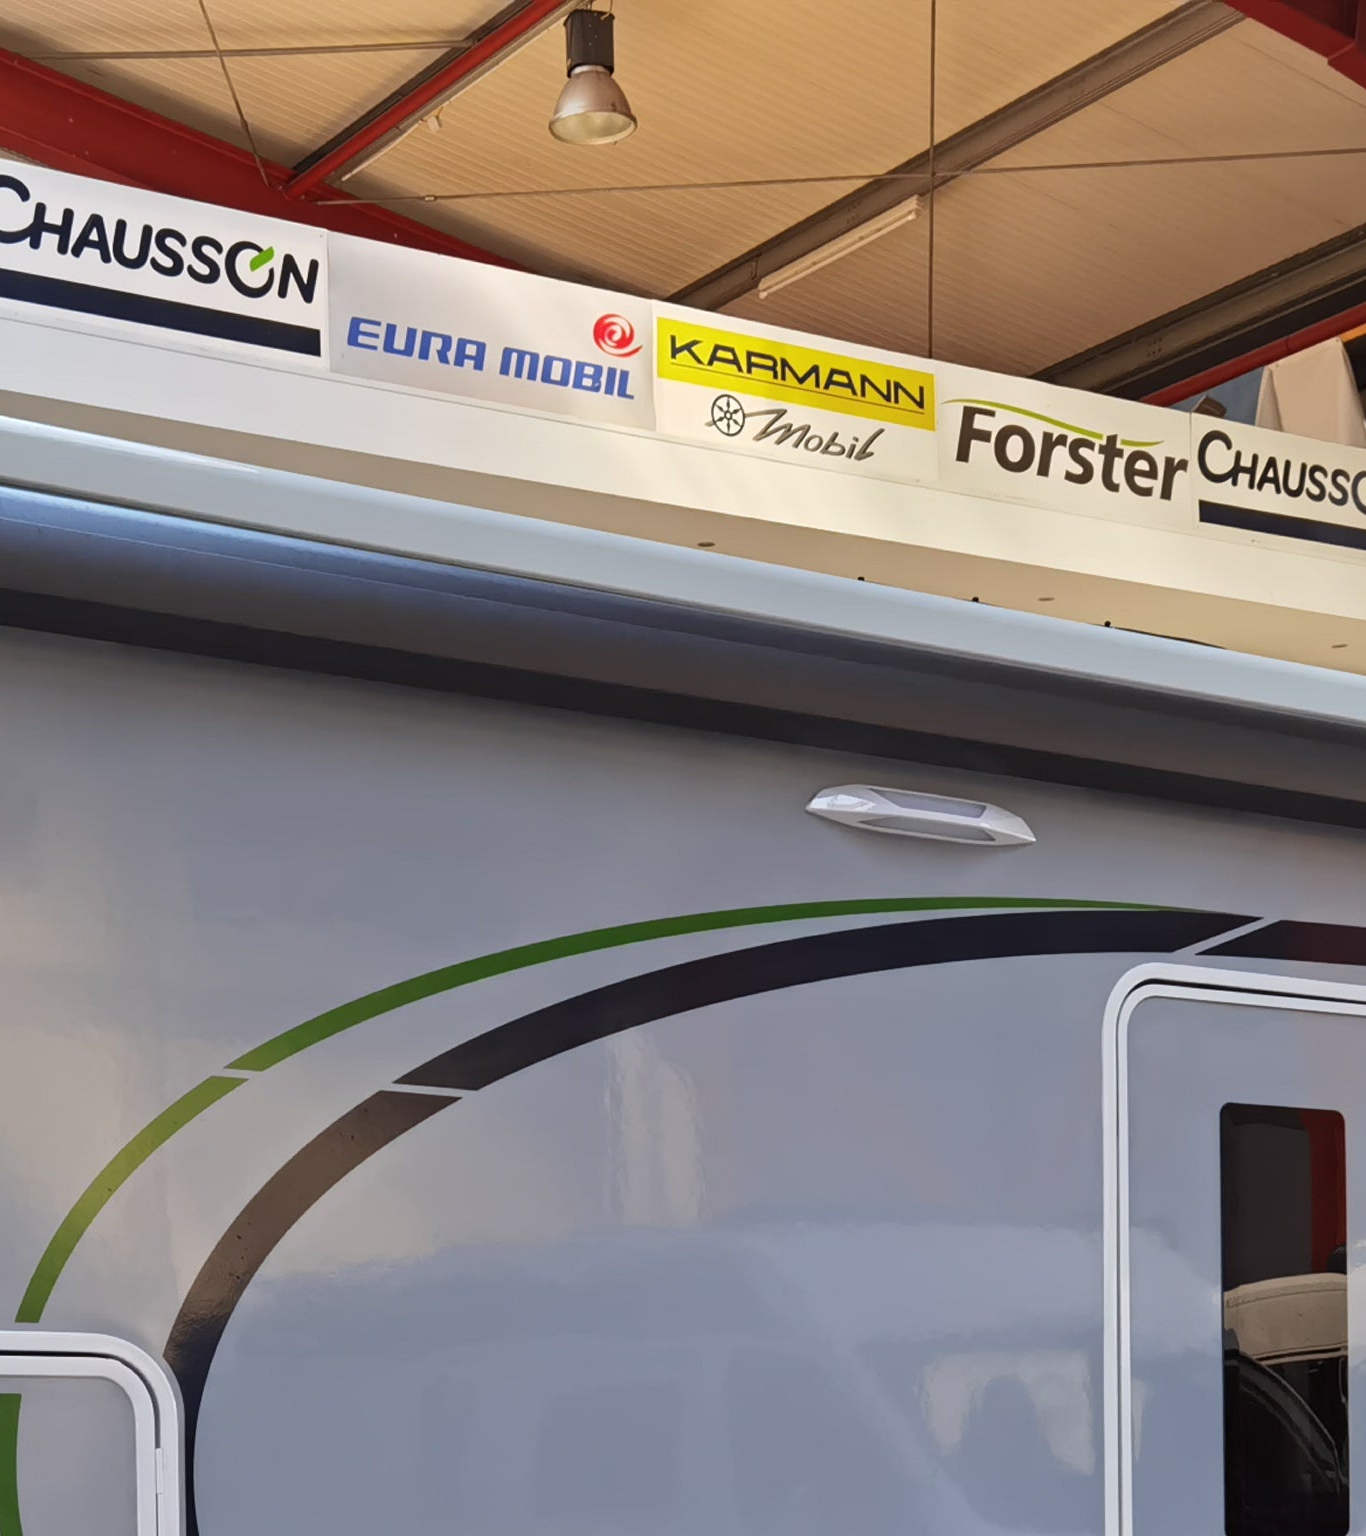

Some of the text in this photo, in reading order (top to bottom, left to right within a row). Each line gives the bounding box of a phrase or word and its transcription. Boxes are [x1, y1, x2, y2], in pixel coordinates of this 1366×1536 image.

[347, 316, 635, 400] EURA MOBIL
[669, 334, 926, 411] KARMANN
[746, 407, 886, 462] Mobil
[955, 404, 1189, 501] Forster
